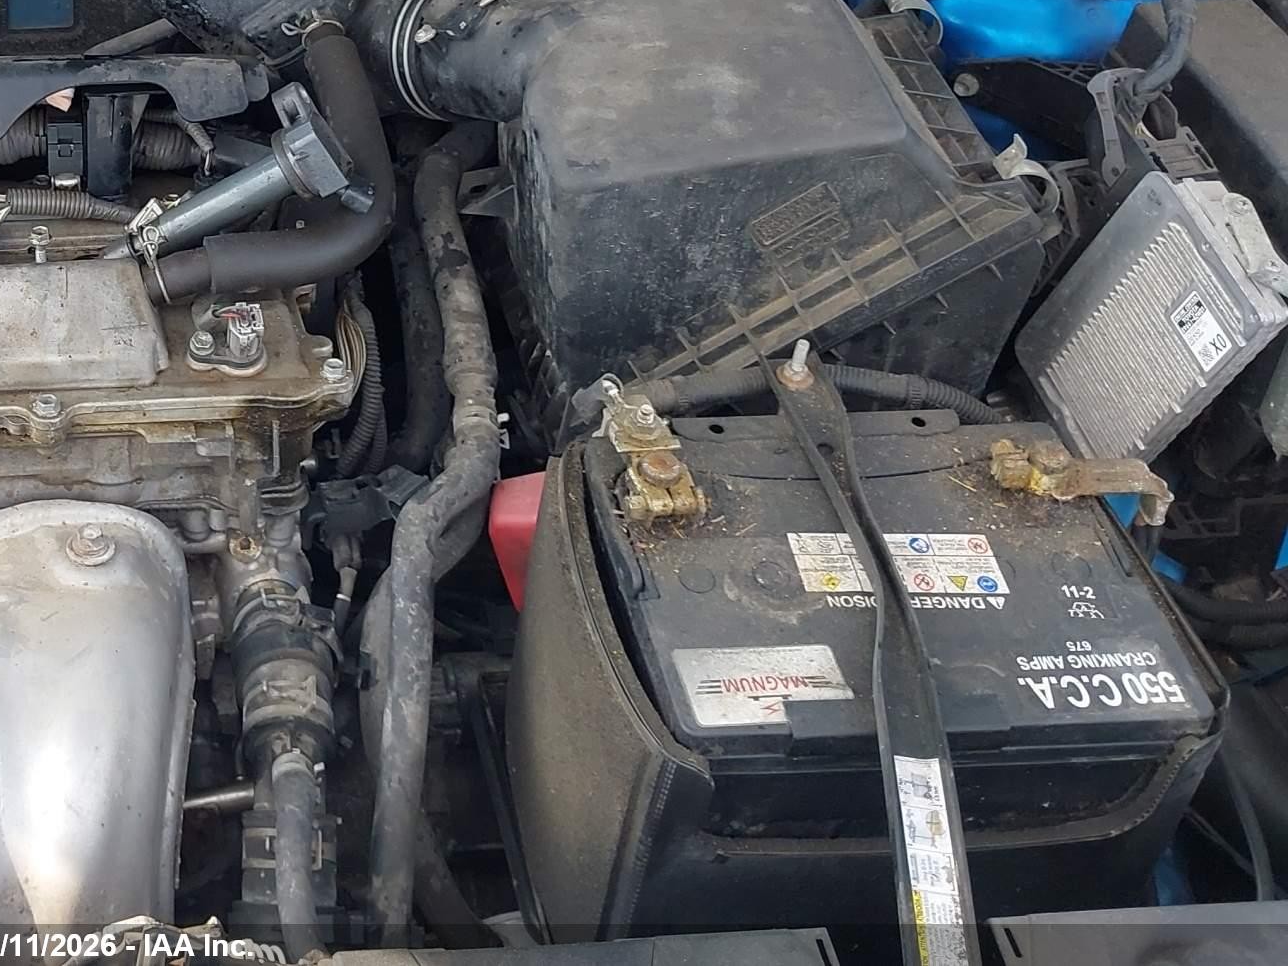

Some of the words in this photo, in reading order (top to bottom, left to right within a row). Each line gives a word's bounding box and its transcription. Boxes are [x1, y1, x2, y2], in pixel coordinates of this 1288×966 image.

[1061, 584, 1096, 599] 11-2
[1066, 640, 1092, 652] 675
[1016, 655, 1064, 671] AMPS
[1067, 651, 1157, 669] CRANKING
[722, 675, 809, 693] MAGNUM
[1016, 673, 1123, 709] C.C.A.
[1121, 671, 1186, 705] 550
